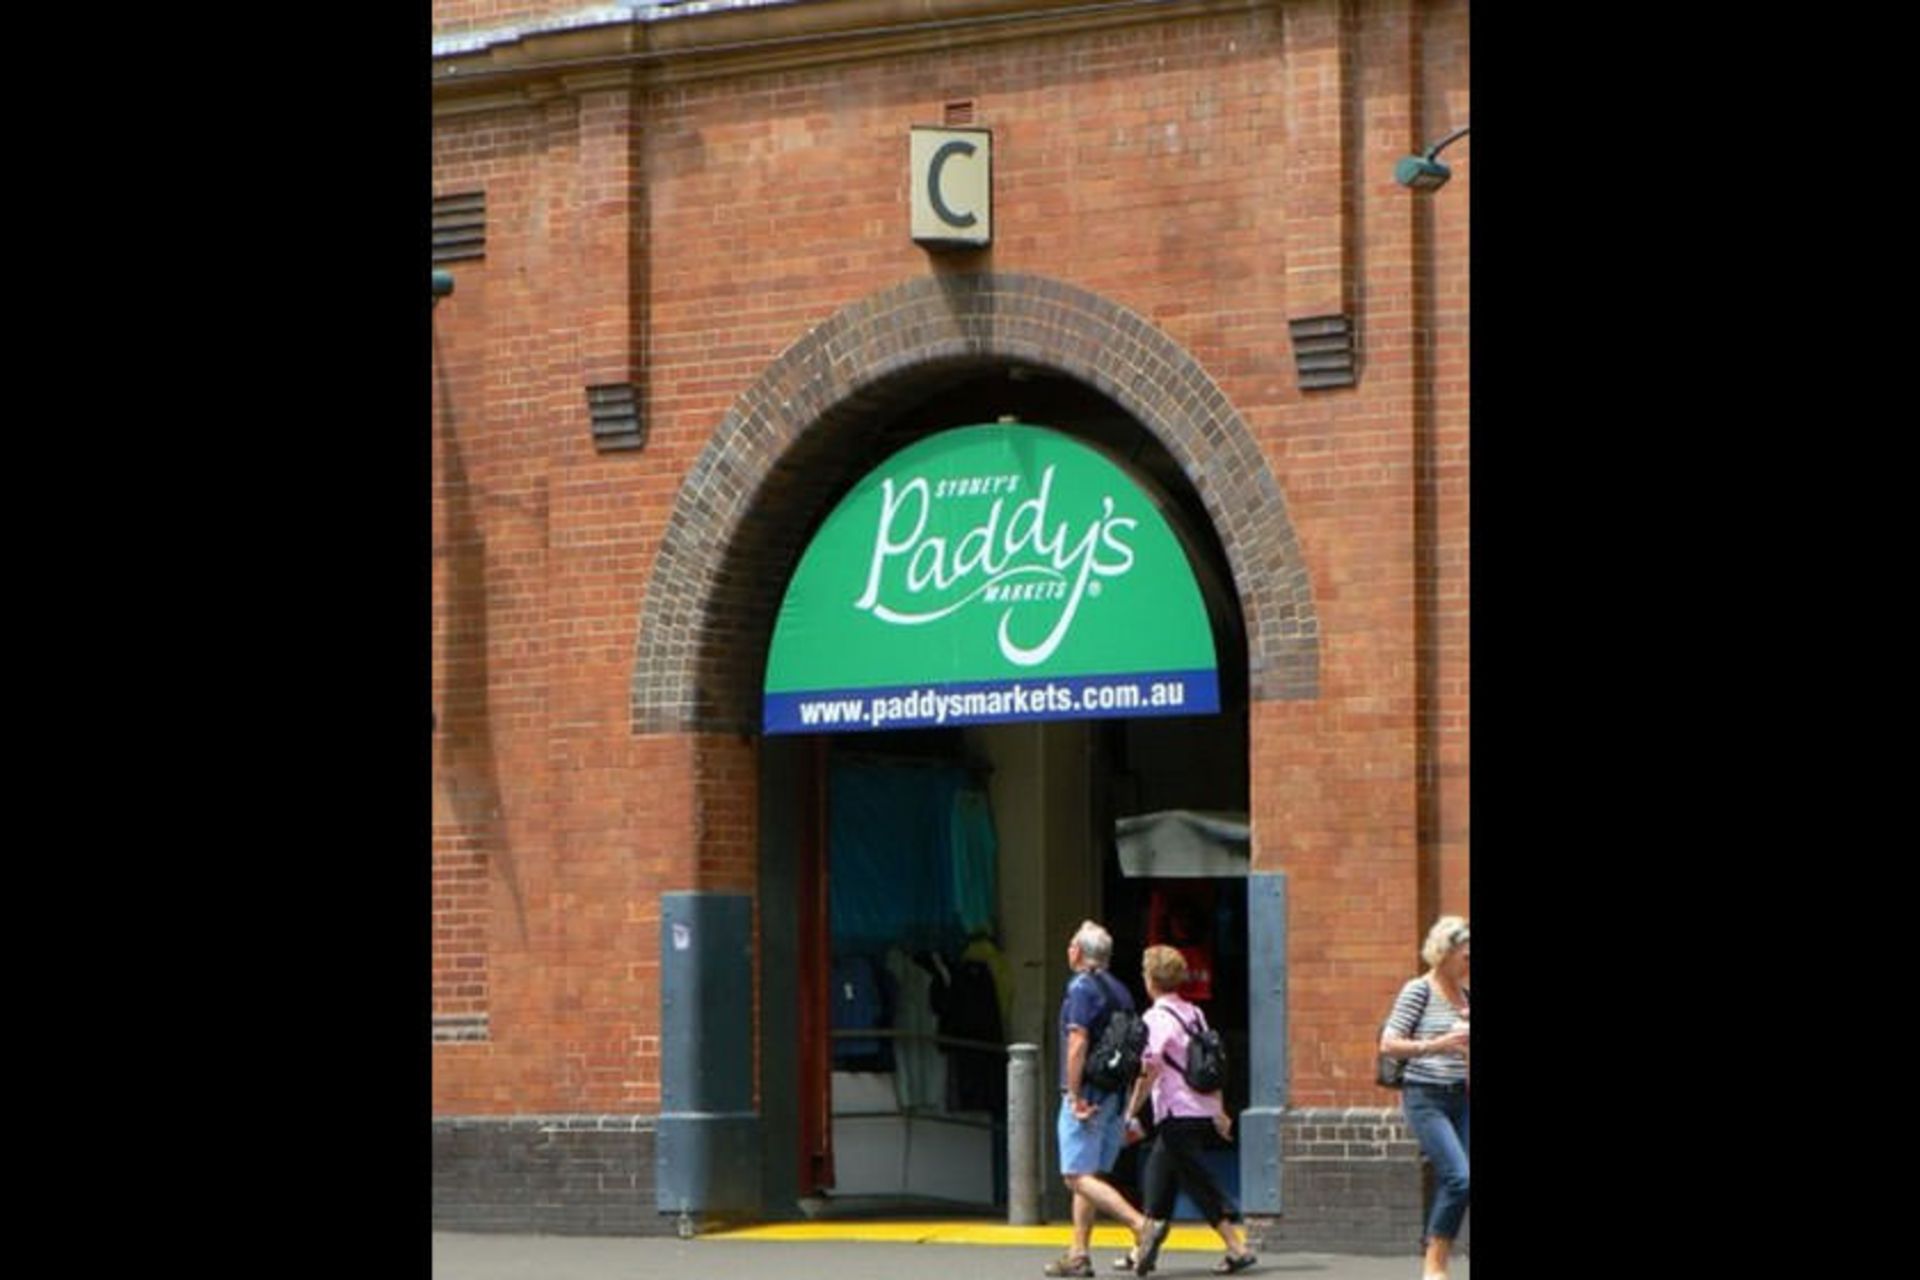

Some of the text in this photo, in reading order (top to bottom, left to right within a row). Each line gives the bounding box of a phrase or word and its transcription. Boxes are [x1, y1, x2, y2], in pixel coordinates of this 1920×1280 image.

[928, 141, 977, 228] C
[935, 475, 1020, 498] SYDNEY'S
[855, 464, 1137, 666] Paddy's
[984, 581, 1067, 602] MARKETS
[801, 682, 1184, 726] www.paddysmarkets.com.au
